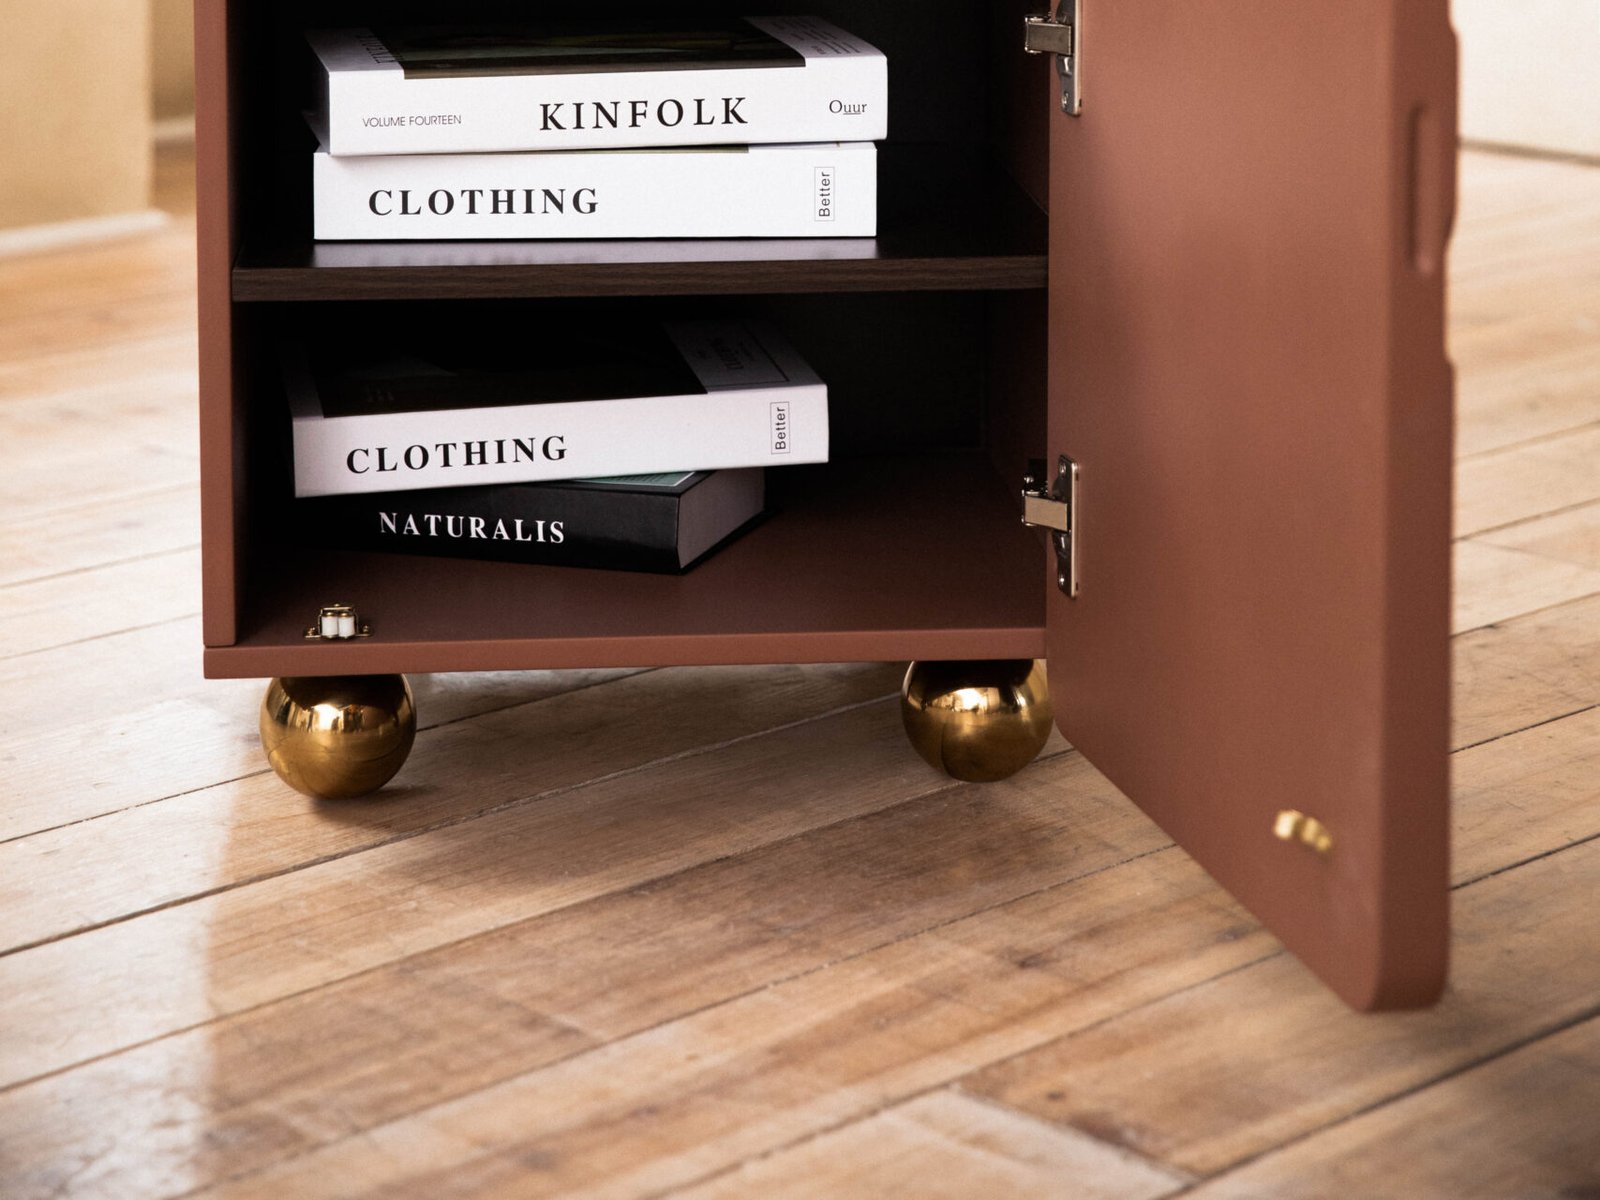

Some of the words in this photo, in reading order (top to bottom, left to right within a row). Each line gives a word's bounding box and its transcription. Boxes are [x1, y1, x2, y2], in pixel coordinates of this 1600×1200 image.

[362, 117, 406, 128] VOLUME
[409, 115, 462, 126] FOURTEEN
[540, 97, 748, 131] KINFOLK
[829, 99, 867, 115] Ouur
[368, 188, 598, 216] CLOTHING
[818, 171, 831, 217] Better
[775, 406, 786, 450] Better
[346, 435, 567, 474] CLOTHING
[379, 512, 565, 544] NATURALIS
